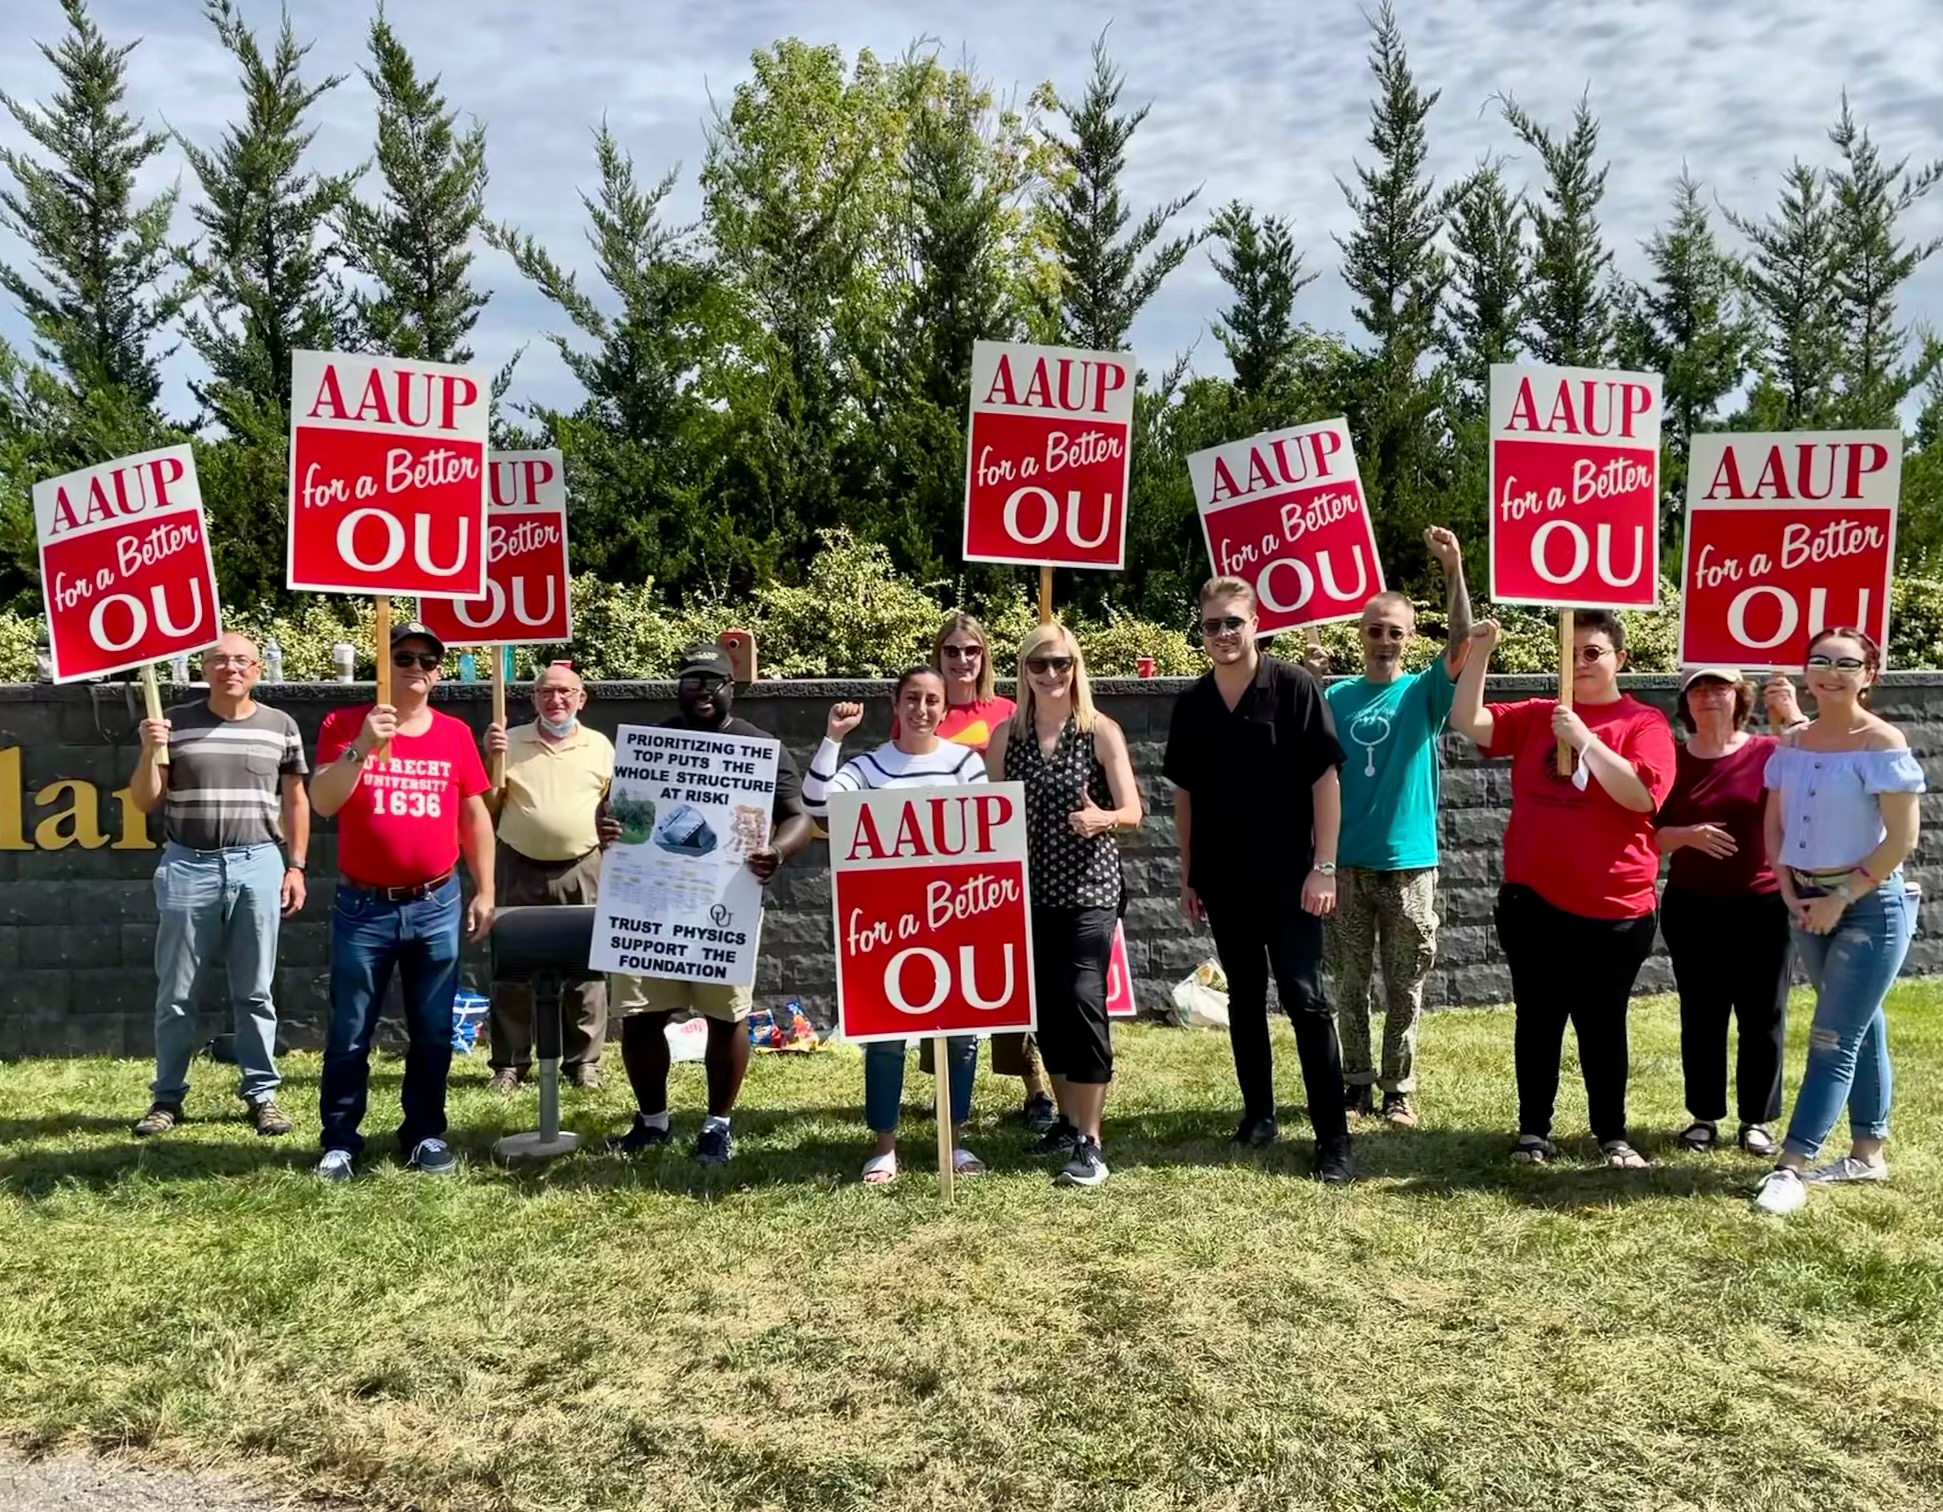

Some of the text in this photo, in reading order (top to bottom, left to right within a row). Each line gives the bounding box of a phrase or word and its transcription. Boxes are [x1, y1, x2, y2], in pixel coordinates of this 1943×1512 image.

[307, 364, 478, 430] AAUP
[983, 353, 1126, 413] AAUP
[1504, 376, 1653, 438] AAUP
[302, 447, 479, 508] for a Better
[488, 460, 554, 507] UP
[977, 430, 1123, 487] for a Better
[1209, 429, 1342, 504] AAUP
[1702, 442, 1889, 500] AAUP
[49, 457, 184, 535] AAUP
[1003, 486, 1113, 549] OU
[1500, 458, 1653, 522] for a Better
[336, 507, 470, 577] OU
[487, 521, 559, 563] Better
[1220, 491, 1359, 576] for a Better
[1530, 520, 1644, 587] OU
[1695, 519, 1885, 590] for a Better
[54, 523, 198, 612] for a Better
[1256, 545, 1367, 613] OU
[89, 577, 203, 652] OU
[453, 575, 555, 628] OU
[627, 733, 773, 760] PRIORITIZING THE
[633, 750, 755, 774] TOP PUTS THE
[363, 773, 448, 792] UNIVERSITY
[373, 788, 441, 818] 1636
[615, 766, 774, 793] WHOLE STRUCTURE
[660, 787, 681, 800] AT
[845, 796, 1013, 861] AAUP
[609, 916, 747, 945] TRUST PHYSICS
[847, 874, 1020, 957] for a Better
[611, 936, 736, 963] SUPPORT THE
[619, 955, 727, 979] FOUNDATION
[883, 943, 1015, 1014] OU
